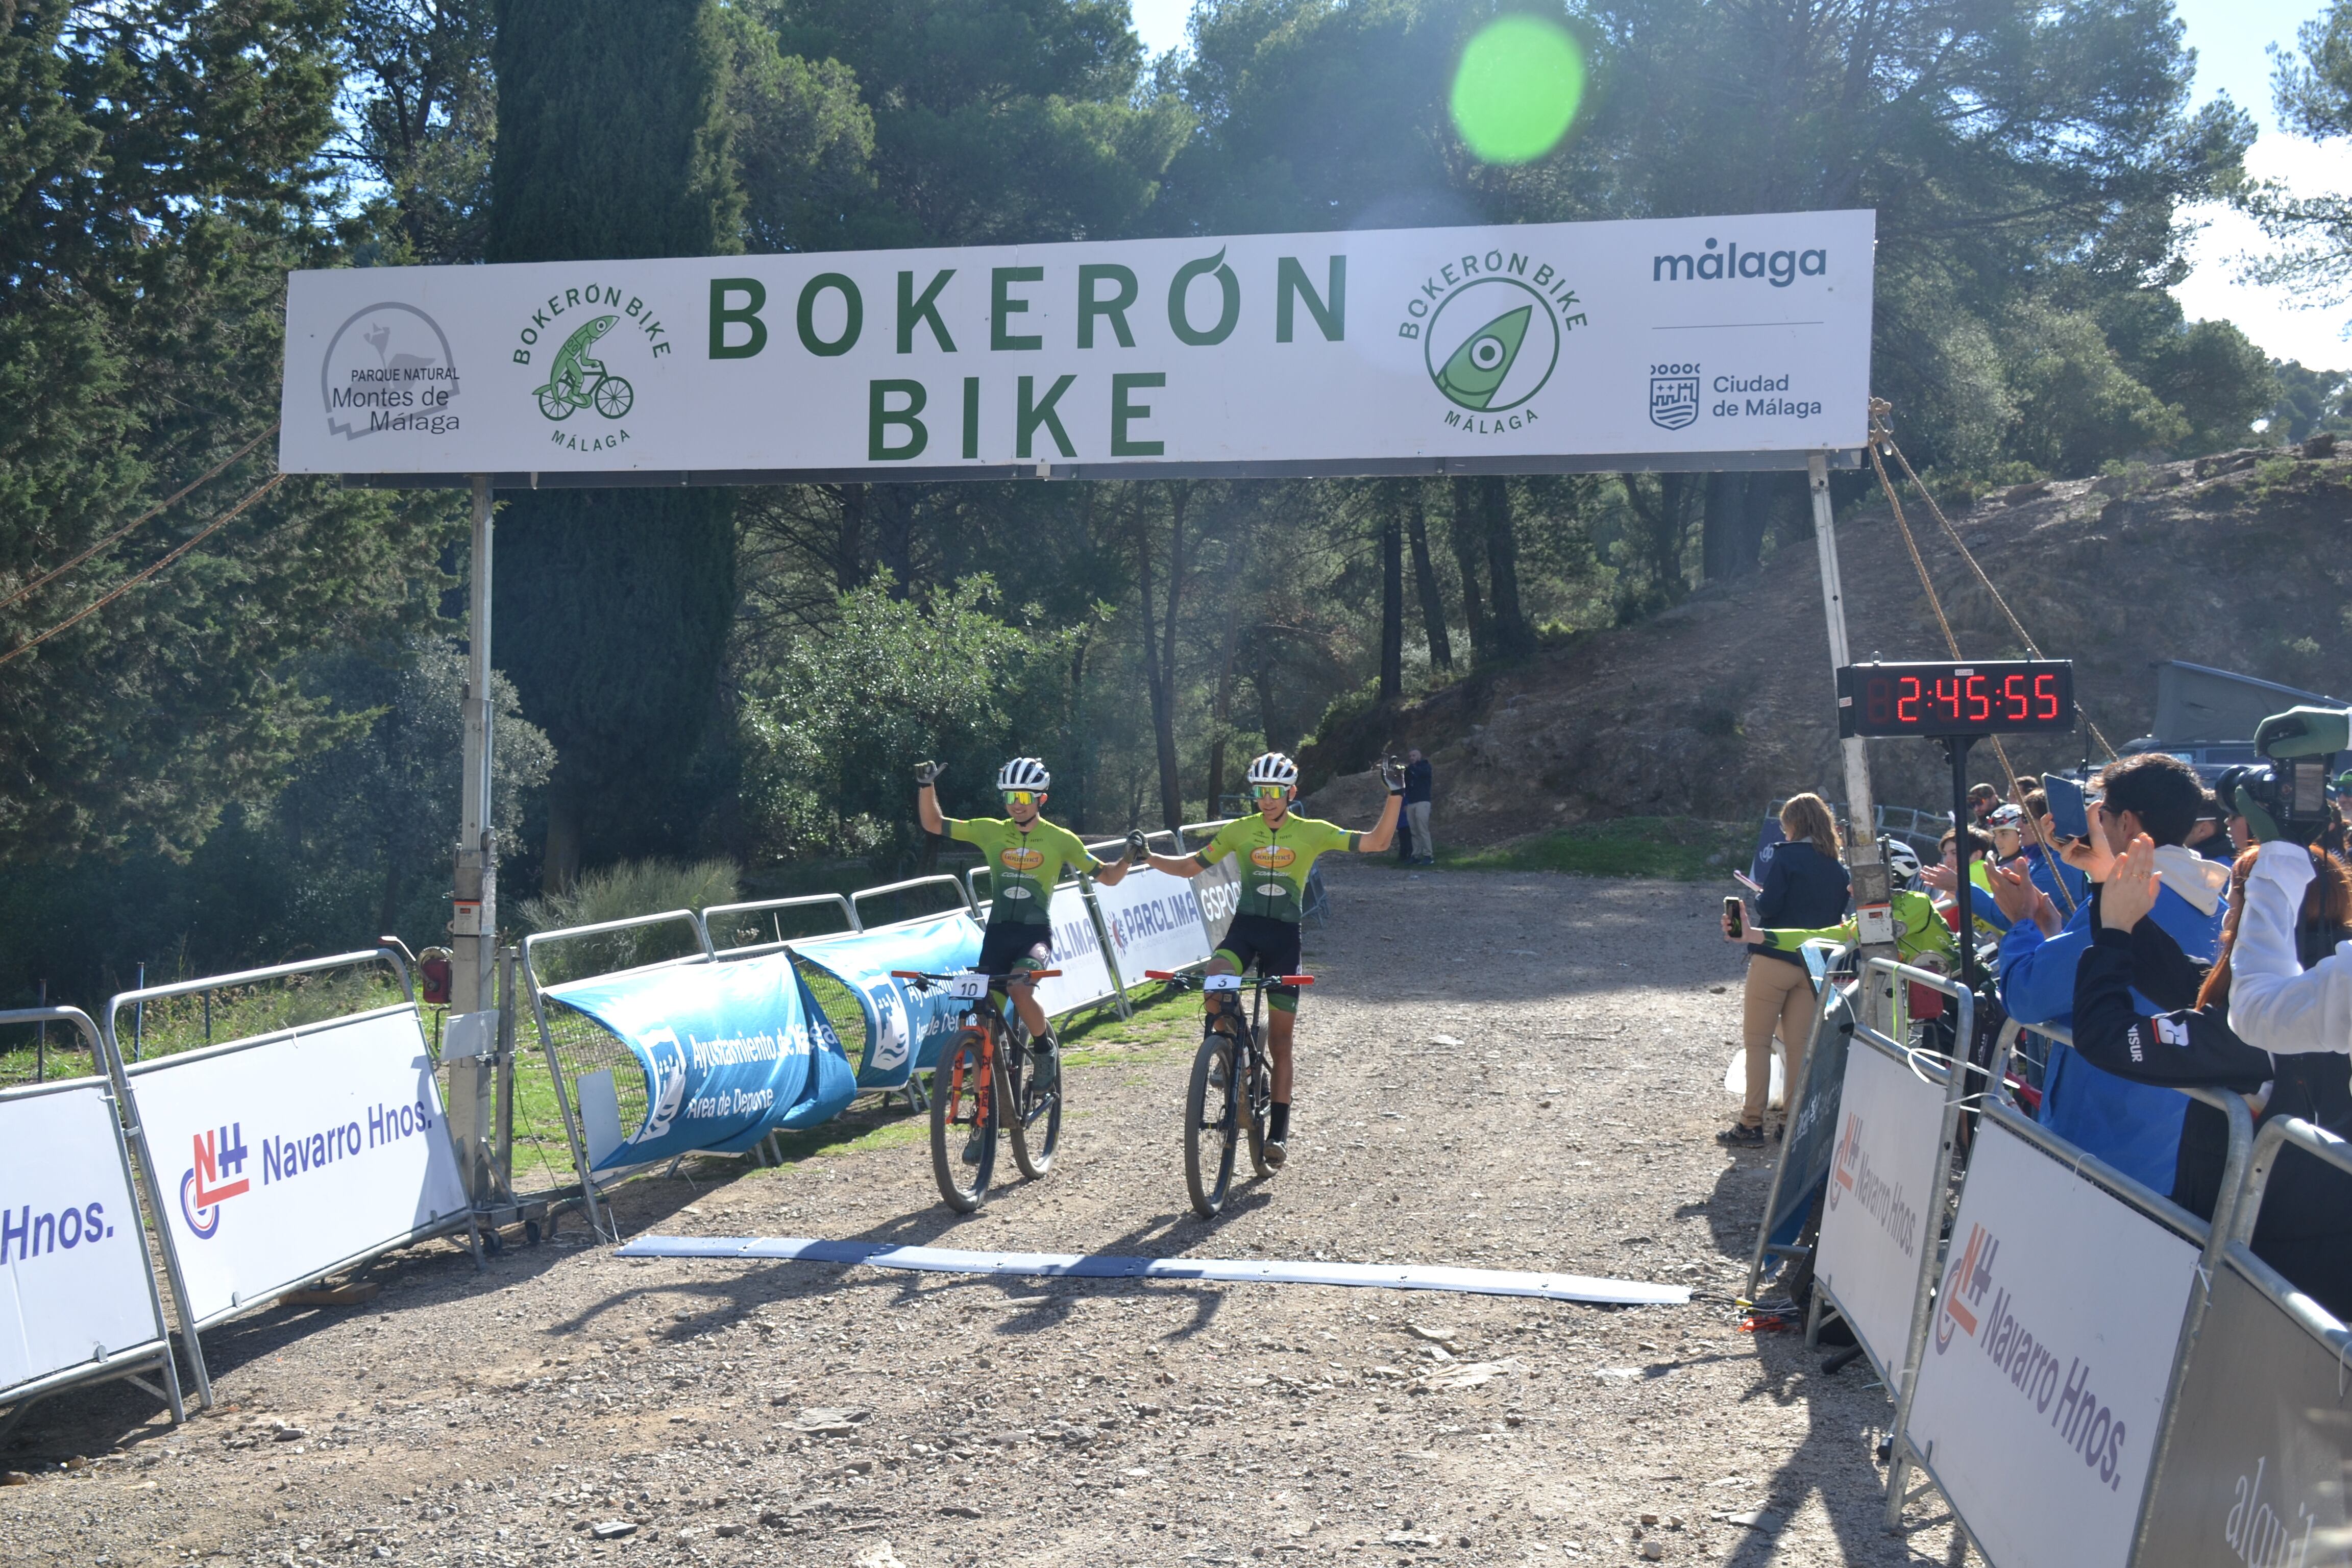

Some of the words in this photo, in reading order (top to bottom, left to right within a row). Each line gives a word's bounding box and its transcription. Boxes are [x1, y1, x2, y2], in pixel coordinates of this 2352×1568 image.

[708, 243, 1347, 360] BOKERÓN
[1399, 248, 1529, 340] BOKERÓN
[1533, 263, 1588, 331] BIKE
[513, 282, 622, 365] BOKERÓN
[625, 297, 671, 358] BIKE
[333, 387, 413, 408] Montes
[422, 385, 449, 406] de
[351, 369, 400, 382] PARQUE
[404, 368, 460, 380] NATURAL
[1713, 374, 1789, 393] Ciudad
[371, 410, 460, 434] Málaga
[868, 372, 1167, 461] BIKE
[1444, 409, 1538, 434] MÁLAGA
[1712, 400, 1739, 417] de
[1745, 398, 1822, 419] Málaga
[551, 429, 630, 452] MÁLAGA
[1898, 674, 2057, 721] 2:45:55
[1123, 891, 1199, 941] PARCLIMA
[961, 983, 978, 996] 10
[1218, 978, 1227, 987] 3
[689, 1031, 776, 1077] Ayuntamiento
[687, 1088, 715, 1119] Área
[717, 1090, 731, 1117] de
[262, 1122, 362, 1186] Navarro
[368, 1100, 432, 1149] Hnos.
[1854, 1151, 1890, 1227] Navarro
[1887, 1181, 1916, 1258] Hnos.
[0, 1202, 114, 1266] Hnos.
[1980, 1286, 2059, 1414] Navarro
[2051, 1356, 2125, 1492] Hnos.
